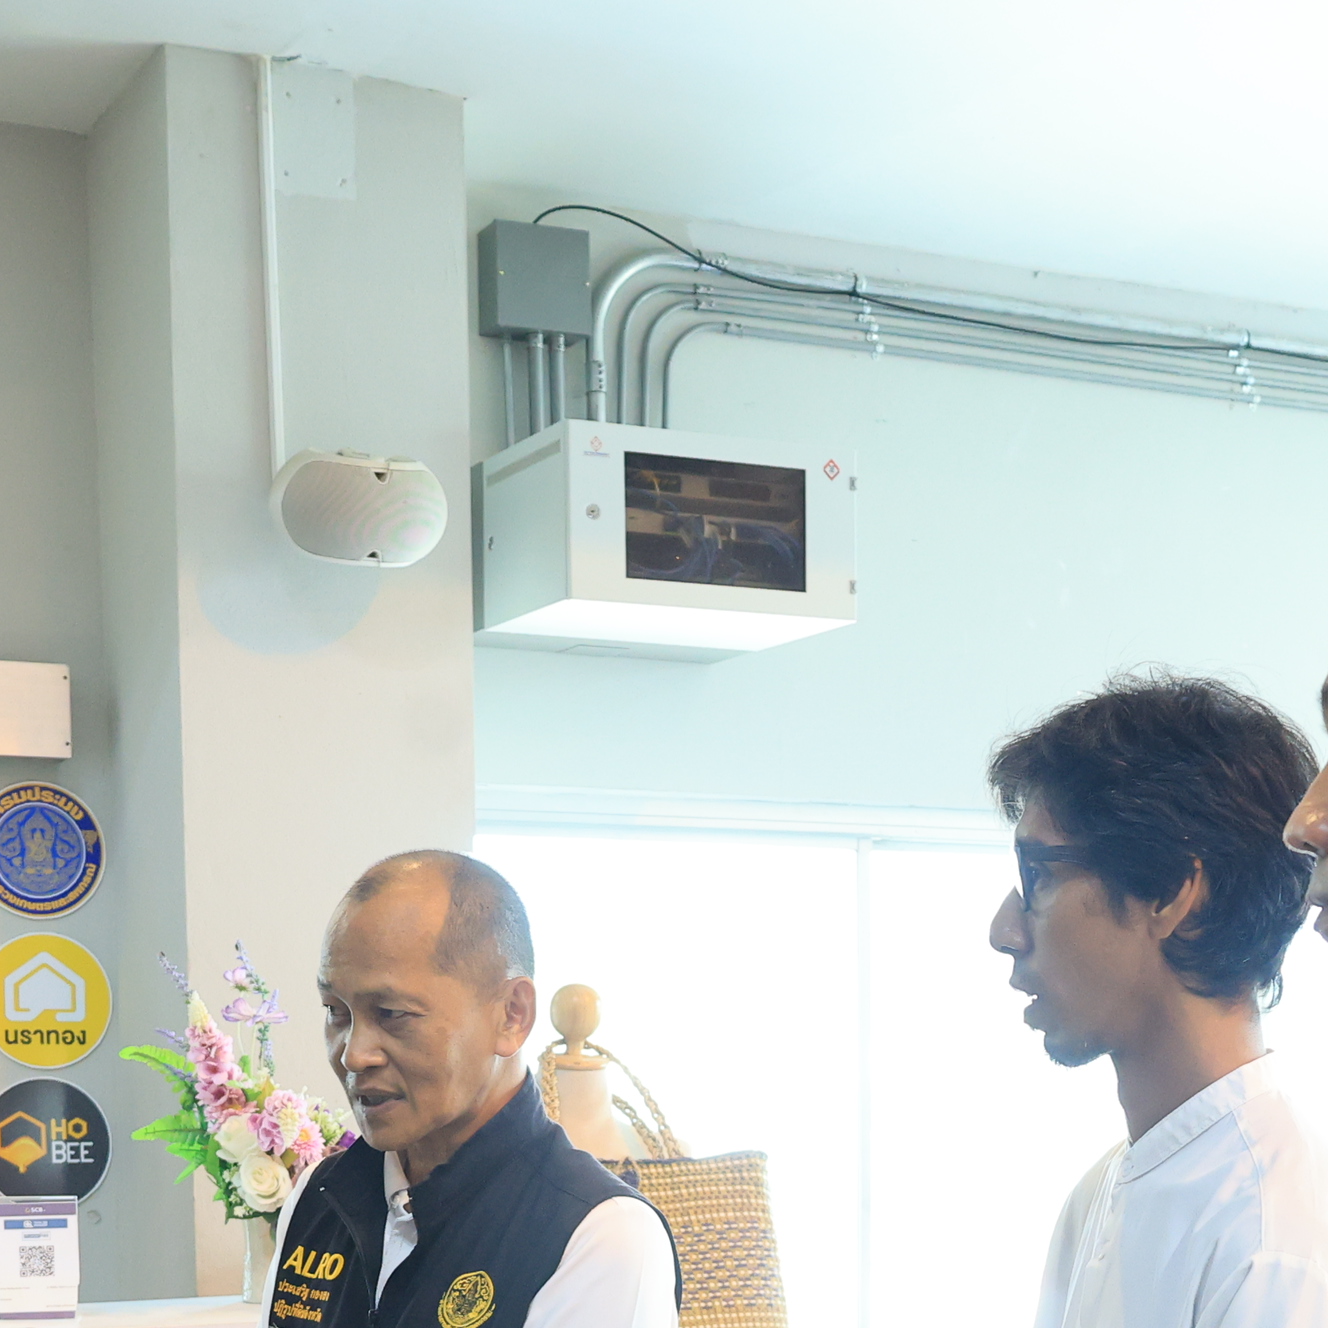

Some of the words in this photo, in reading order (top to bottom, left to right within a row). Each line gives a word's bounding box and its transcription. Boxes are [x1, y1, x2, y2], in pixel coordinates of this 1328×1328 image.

[5, 1029, 86, 1045] นราทอง
[51, 1117, 88, 1140] HO
[52, 1141, 94, 1164] BEE
[283, 1245, 345, 1280] ALRO
